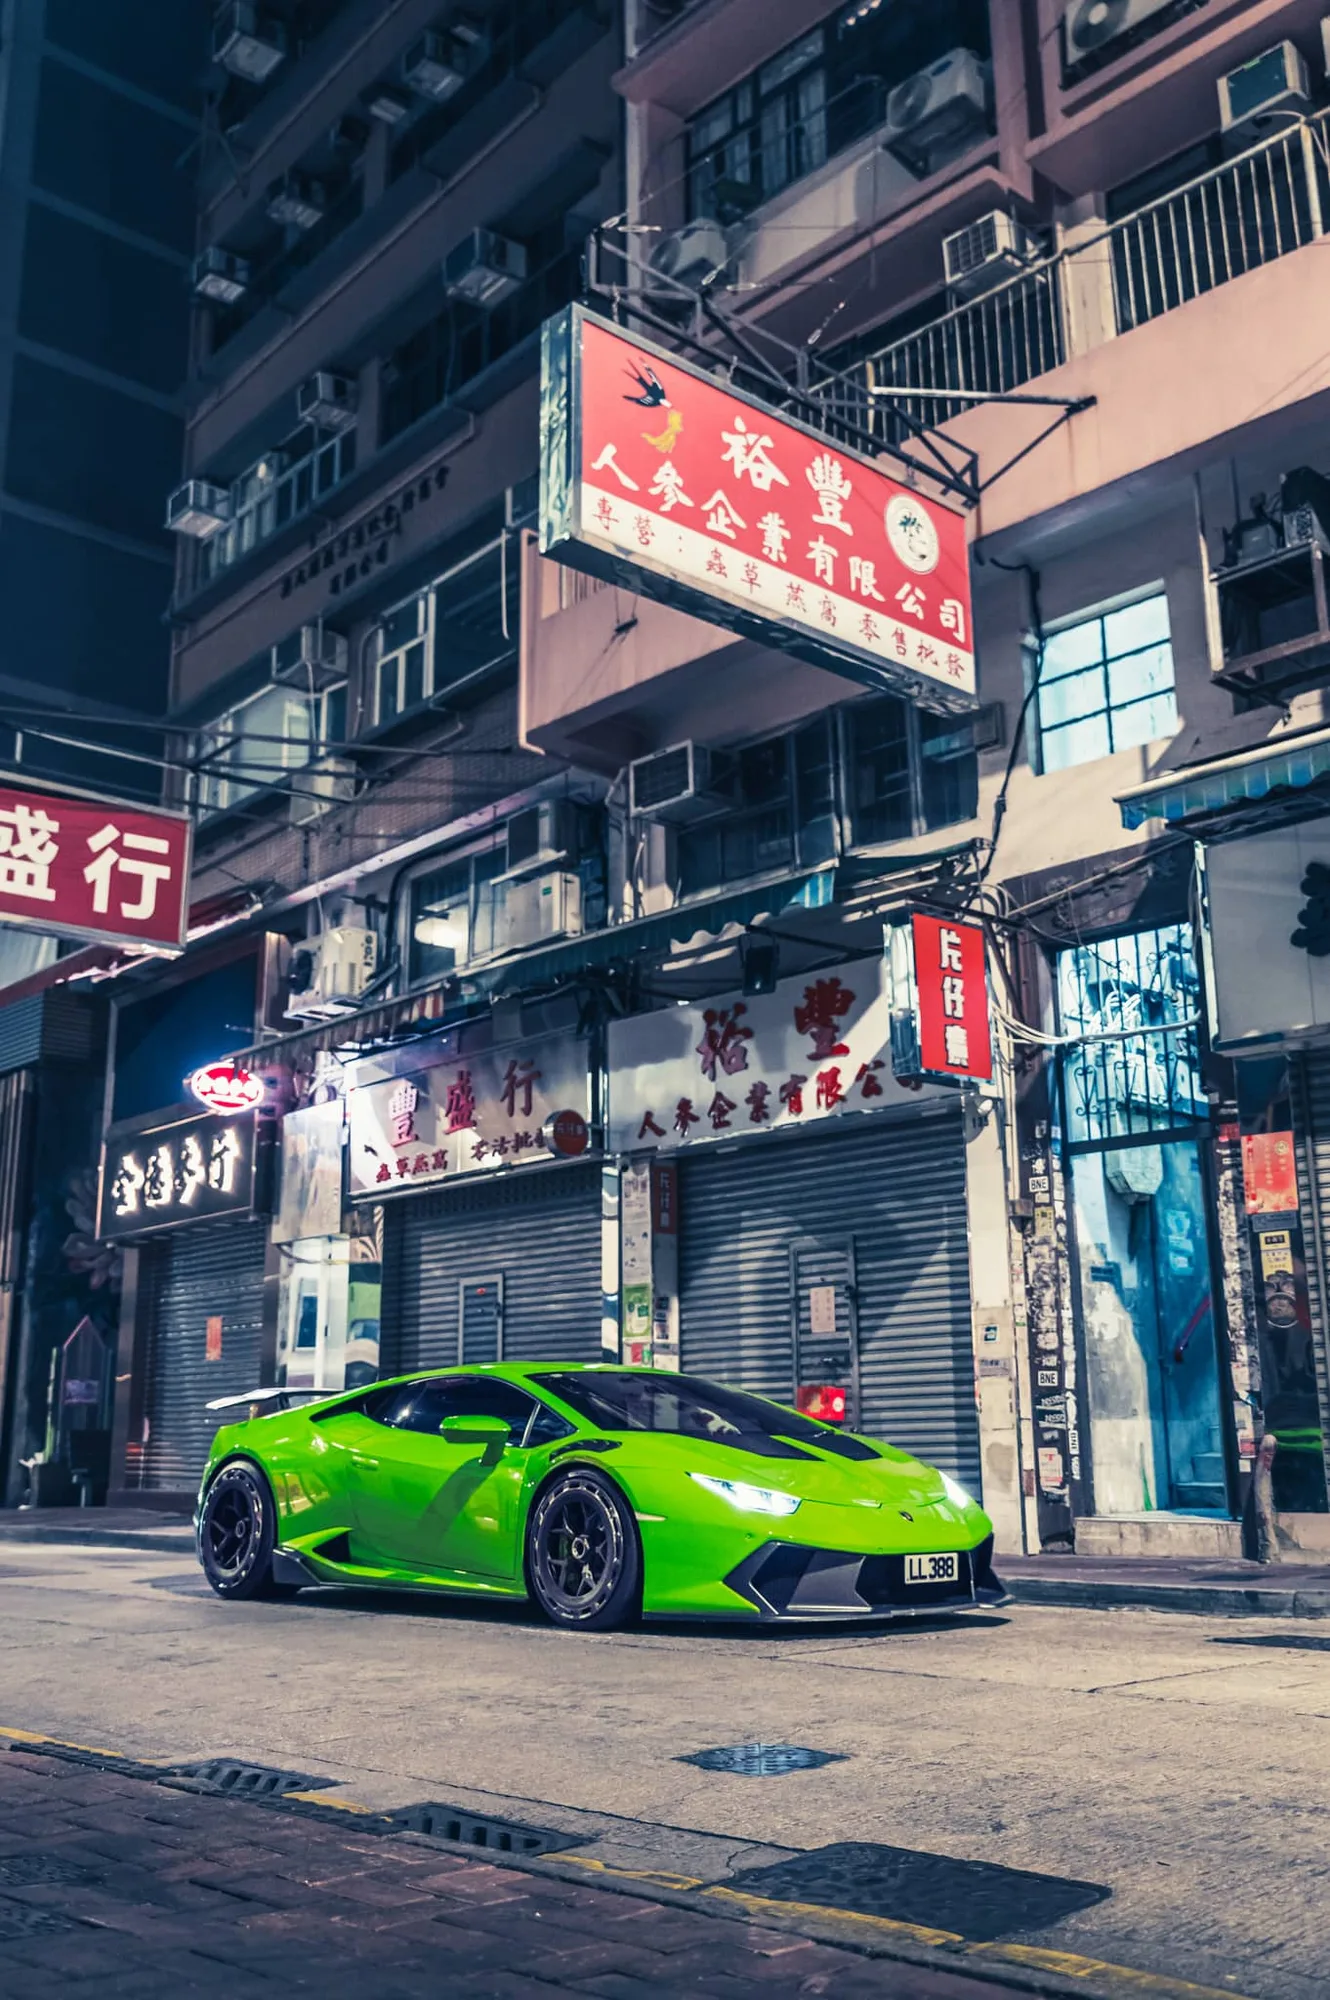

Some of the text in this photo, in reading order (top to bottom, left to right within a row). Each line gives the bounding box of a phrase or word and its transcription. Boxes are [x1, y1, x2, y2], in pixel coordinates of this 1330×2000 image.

[721, 416, 854, 537] 裕豐
[590, 443, 967, 645] 人參企業有限公司
[0, 804, 172, 921] 盛行
[389, 1059, 543, 1149] 豐盛行
[637, 1058, 923, 1140] 人參企業有限公
[1031, 1178, 1047, 1190] BNE
[1040, 1372, 1056, 1384] BNE
